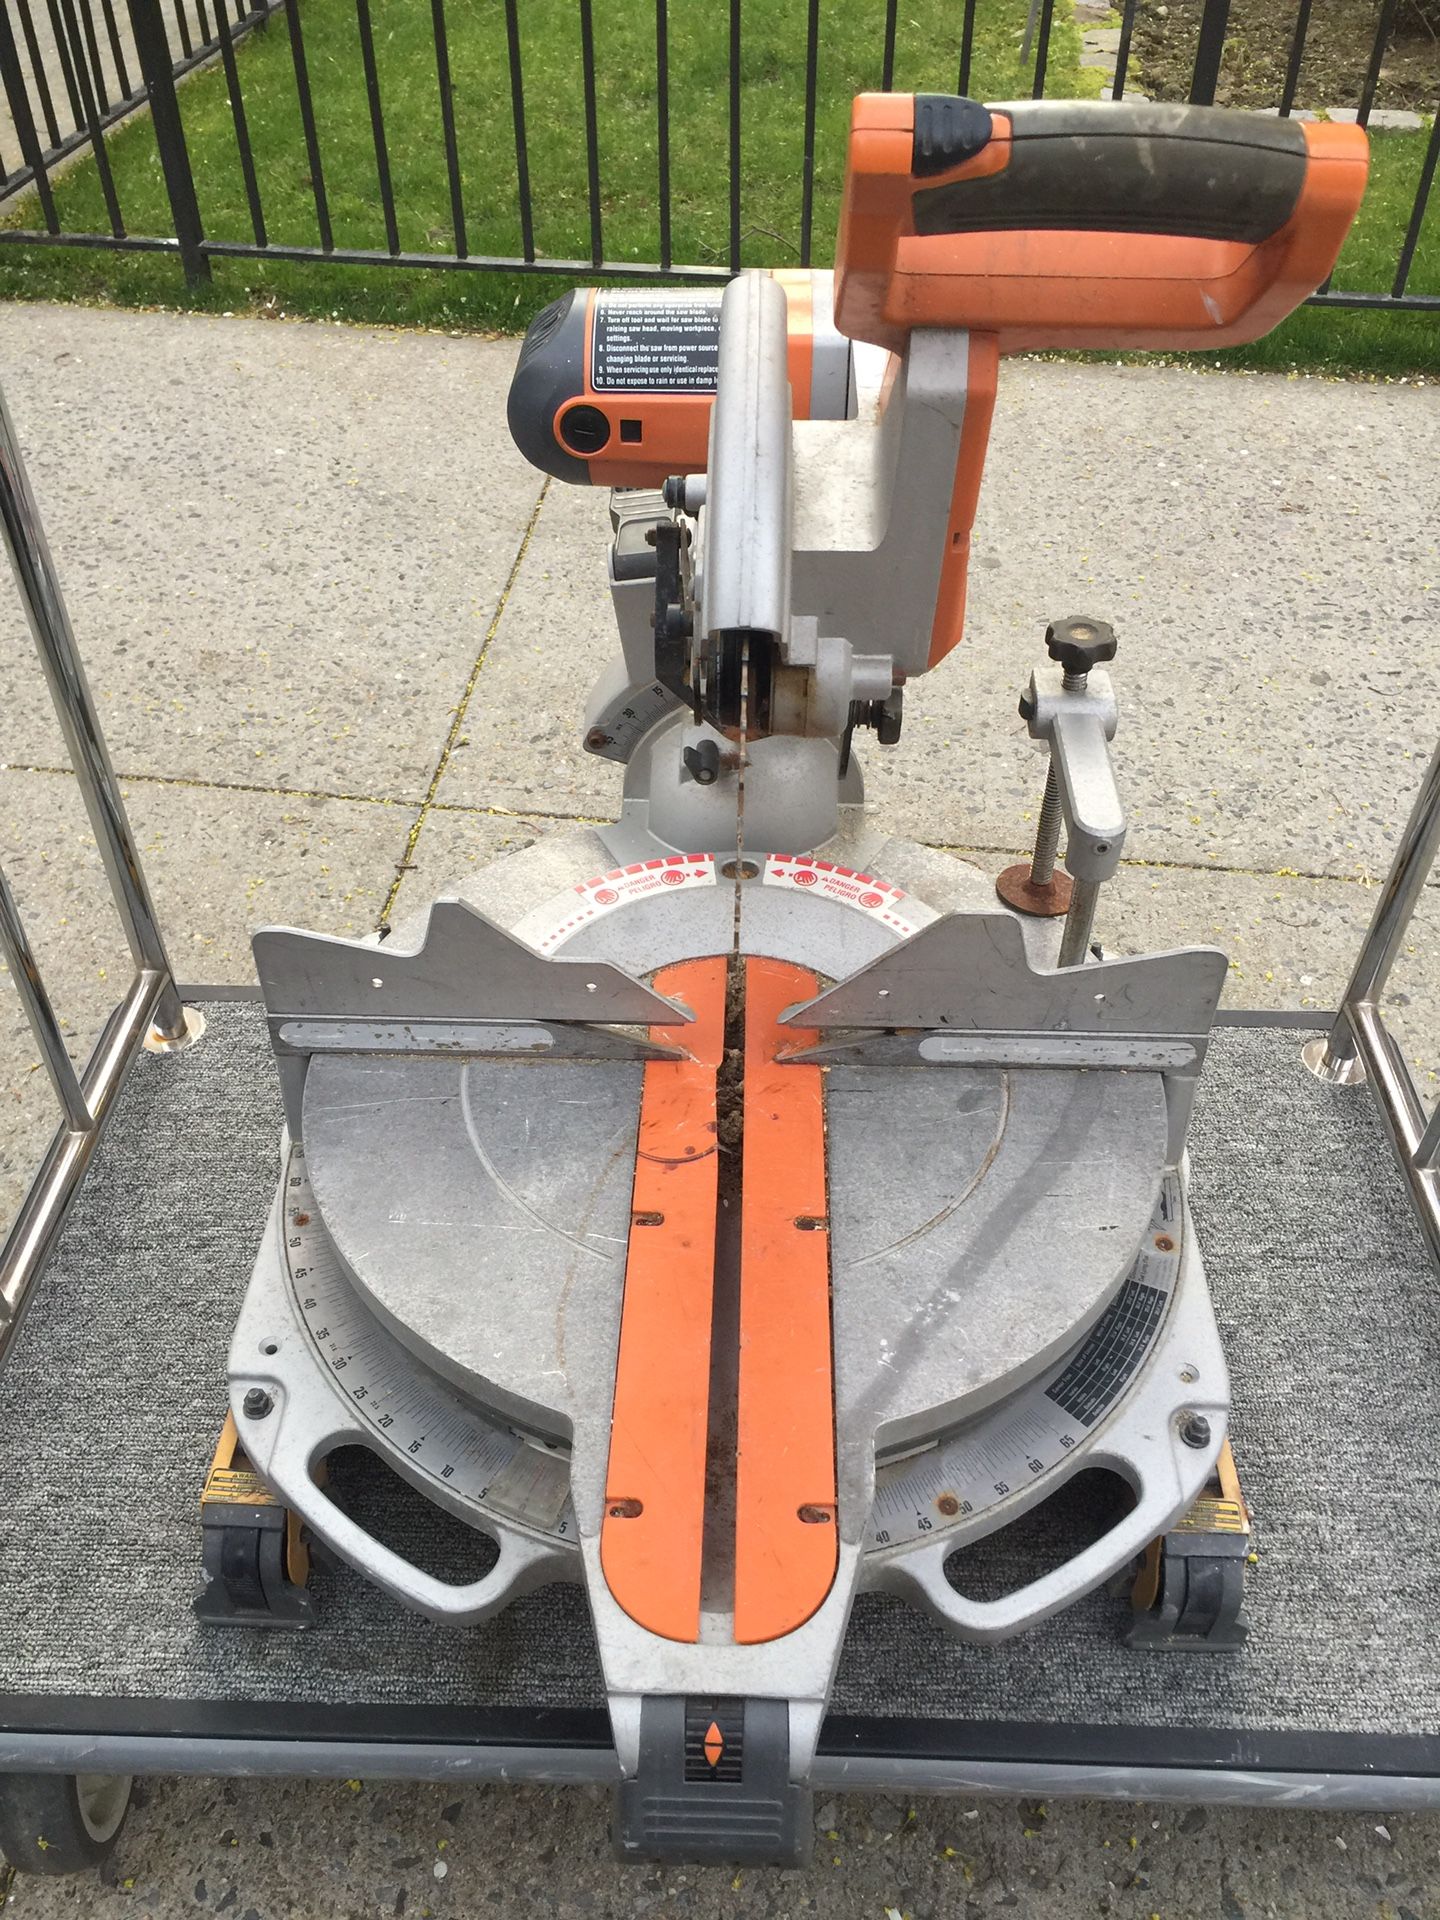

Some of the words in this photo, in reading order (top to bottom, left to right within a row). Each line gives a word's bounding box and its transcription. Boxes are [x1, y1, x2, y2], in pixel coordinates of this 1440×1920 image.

[606, 335, 632, 343] settings.
[606, 344, 639, 352] Disconnect
[606, 356, 633, 364] changing
[624, 366, 649, 374] servicing
[660, 366, 672, 374] only
[696, 377, 713, 386] damp
[651, 686, 664, 697] 15
[622, 708, 635, 719] 30
[624, 874, 656, 888] DANGER
[628, 880, 662, 895] PELIGRO
[830, 878, 860, 893] DANGER
[824, 884, 857, 900] PELIGRO
[290, 1177, 302, 1188] 60
[288, 1236, 302, 1248] 50
[294, 1268, 308, 1280] 45
[302, 1298, 317, 1310] 40
[316, 1327, 330, 1340] 35
[332, 1356, 348, 1370] 30
[352, 1386, 368, 1400] 25
[378, 1413, 394, 1429] 20
[407, 1440, 422, 1454] 15
[1059, 1434, 1076, 1449] 65
[440, 1464, 454, 1478] 10
[1028, 1458, 1044, 1474] 60
[478, 1487, 489, 1500] 5
[994, 1480, 1010, 1496] 55
[958, 1500, 974, 1515] 50
[558, 1521, 568, 1534] 5
[917, 1516, 933, 1531] 45
[875, 1530, 890, 1544] 40
